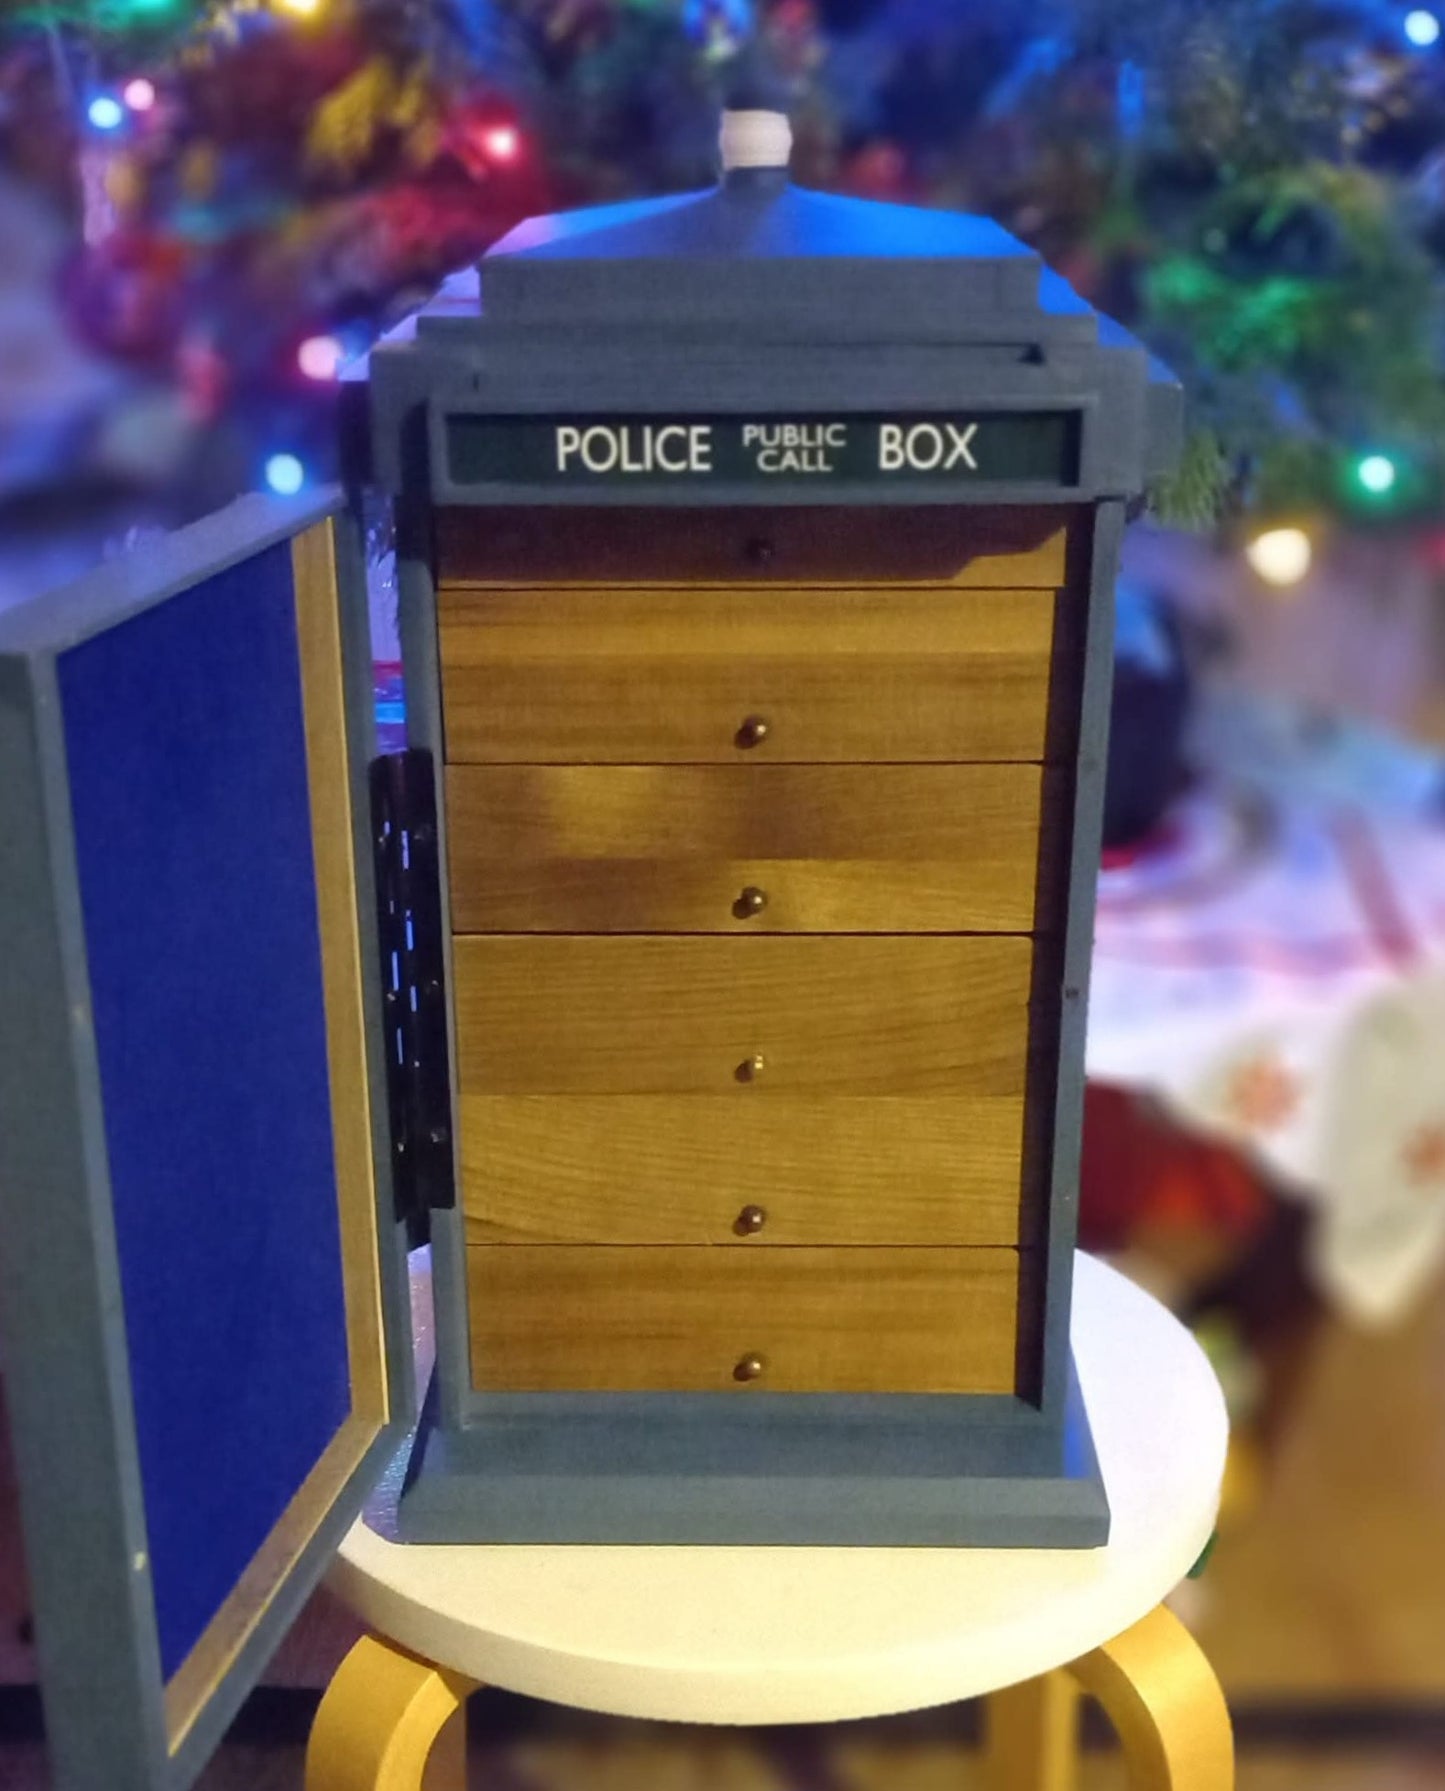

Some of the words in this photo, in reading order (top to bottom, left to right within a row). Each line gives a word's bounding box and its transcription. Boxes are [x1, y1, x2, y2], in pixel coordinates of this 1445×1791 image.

[556, 425, 712, 472] POLICE
[743, 424, 846, 447] PUBLIC
[879, 423, 978, 471] BOX
[757, 448, 832, 472] CALL
